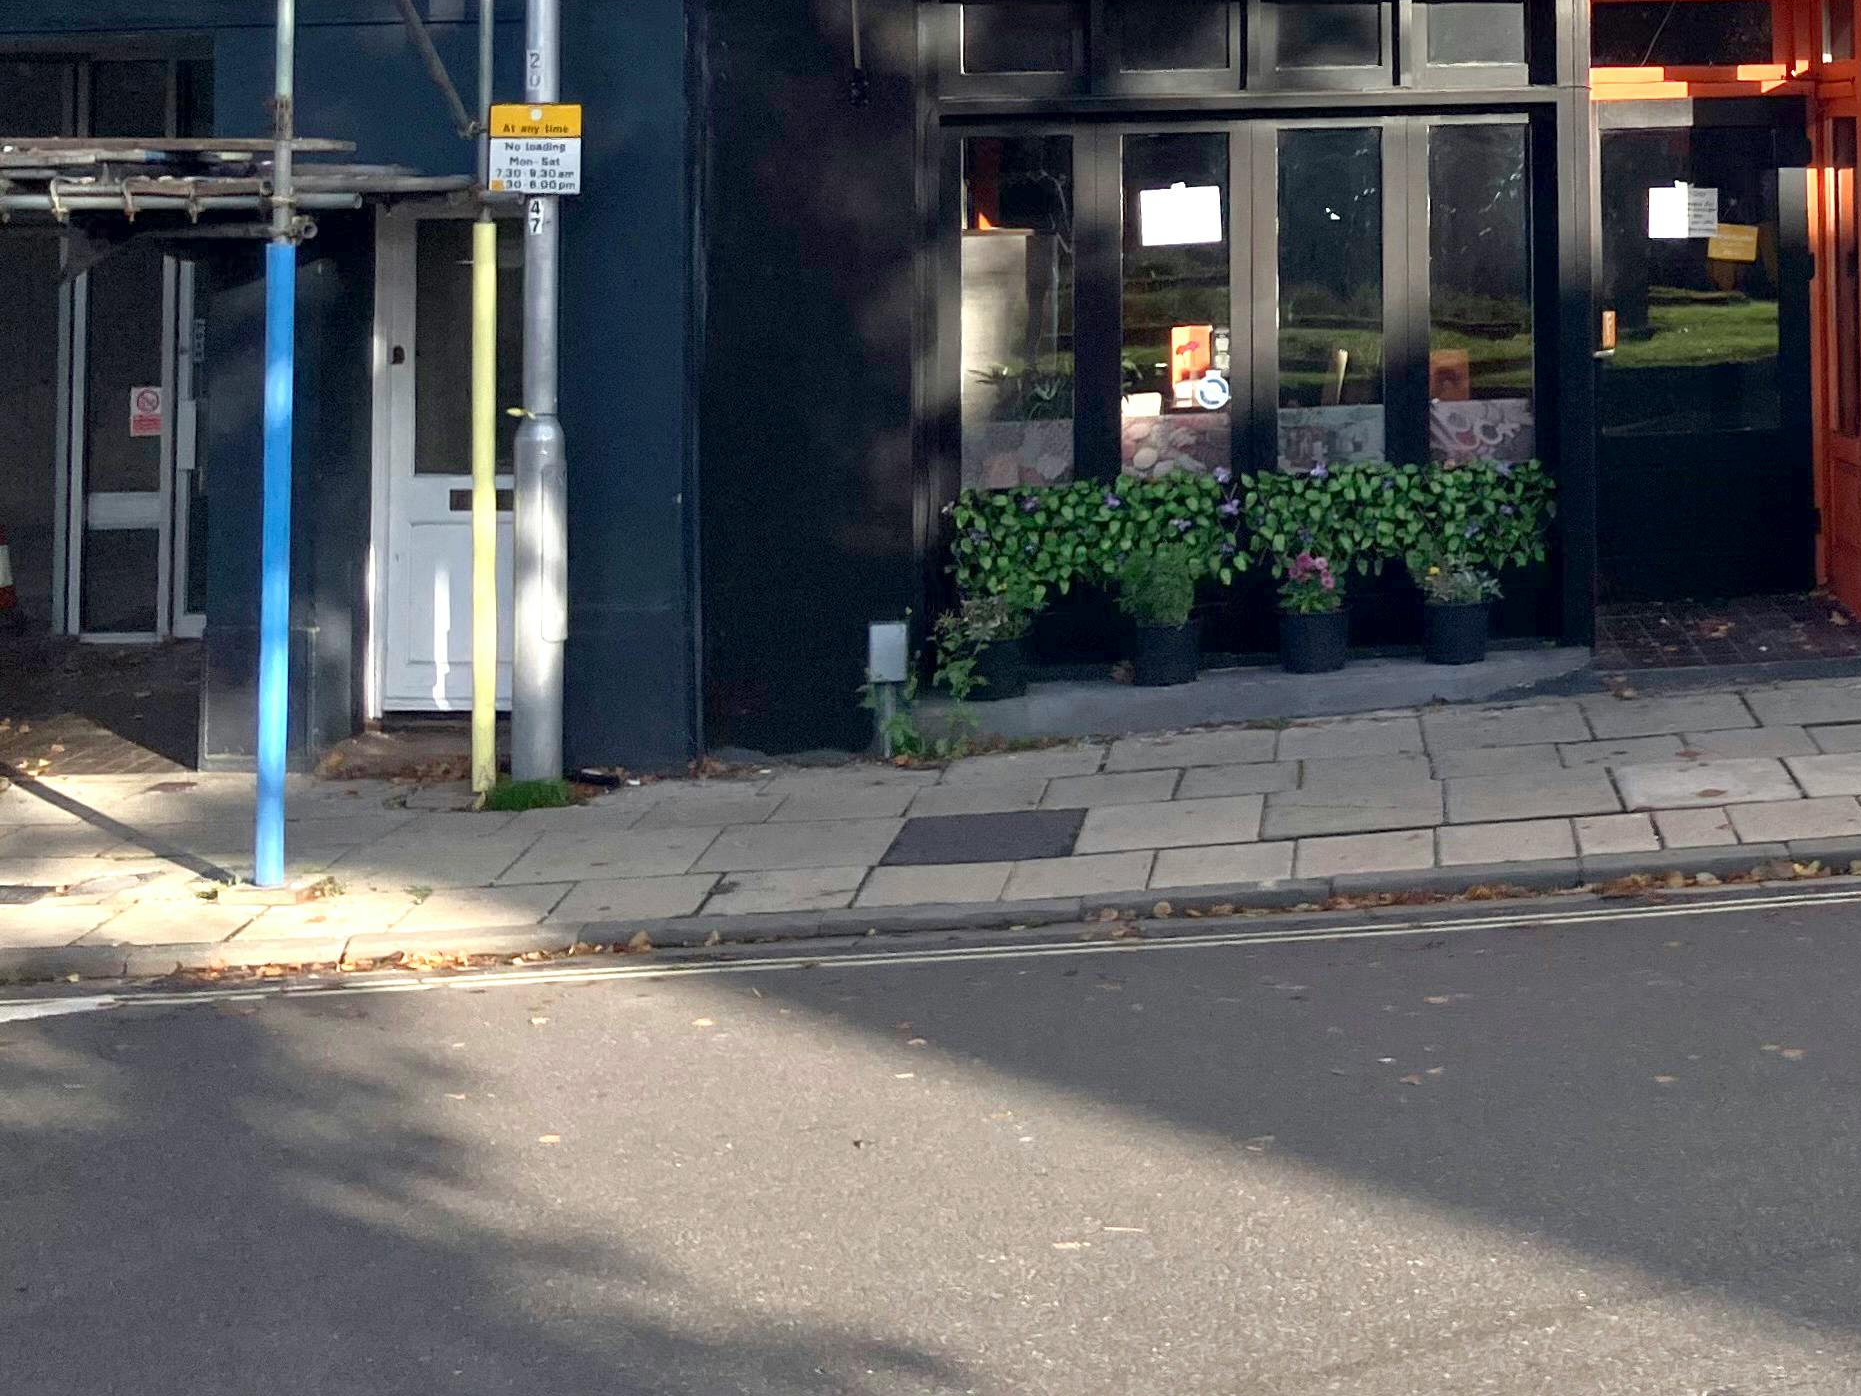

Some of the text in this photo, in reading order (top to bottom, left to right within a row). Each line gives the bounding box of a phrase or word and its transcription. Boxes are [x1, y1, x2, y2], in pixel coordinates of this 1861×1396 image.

[503, 124, 569, 135] At any time
[505, 142, 566, 153] No loading
[509, 156, 533, 166] Mon
[541, 157, 560, 166] Sat
